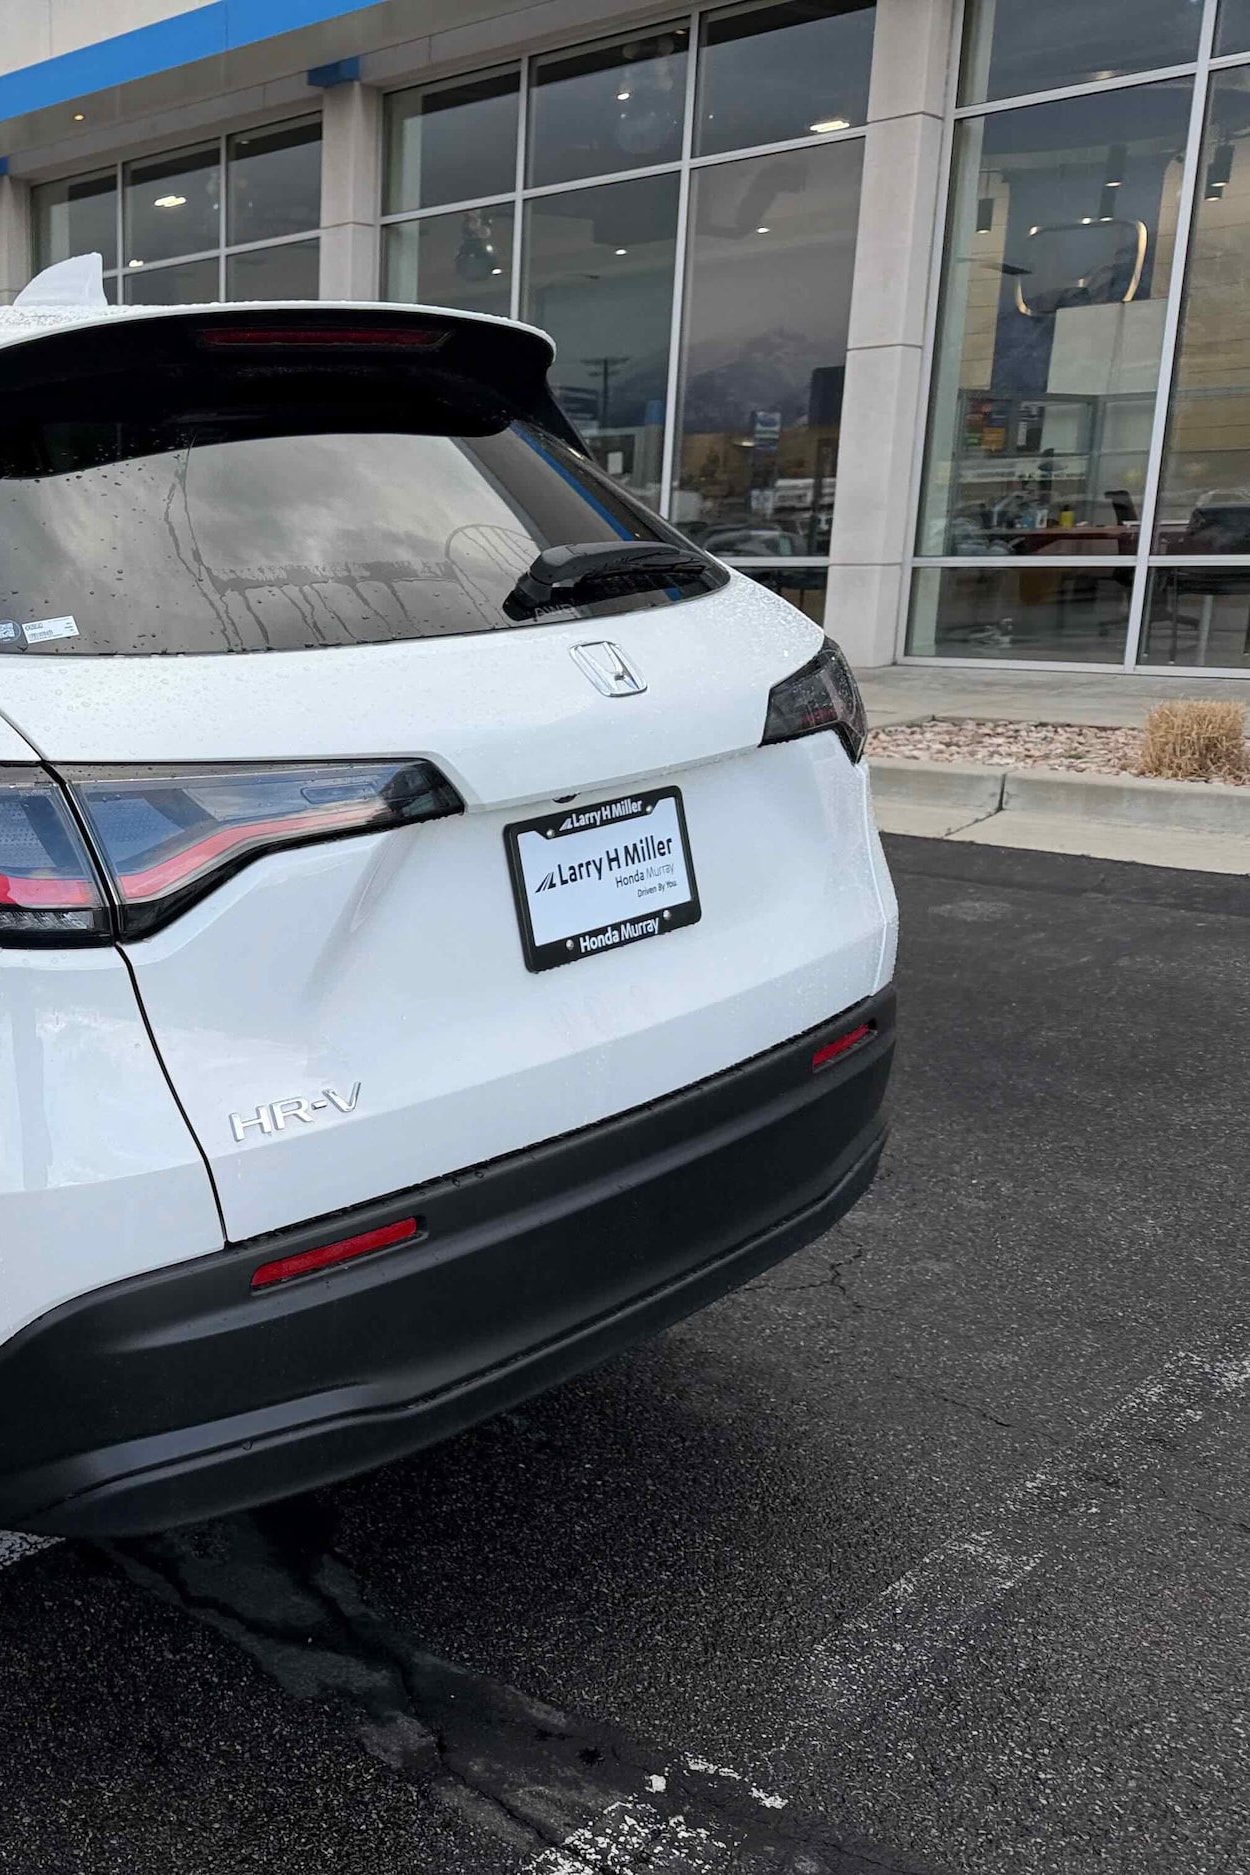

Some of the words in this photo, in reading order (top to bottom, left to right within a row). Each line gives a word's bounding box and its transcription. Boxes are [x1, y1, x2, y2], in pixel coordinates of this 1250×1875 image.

[572, 809, 601, 826] Larry
[601, 804, 611, 821] H
[611, 799, 643, 817] Miller
[558, 857, 602, 885] Larry
[606, 848, 621, 871] H
[624, 835, 672, 866] Miller
[615, 870, 644, 888] Honda
[646, 863, 674, 879] Murray
[637, 886, 657, 897] Driven
[658, 883, 665, 893] By
[580, 927, 619, 952] Honda
[620, 918, 659, 940] Murray
[229, 1081, 362, 1142] HR-V
